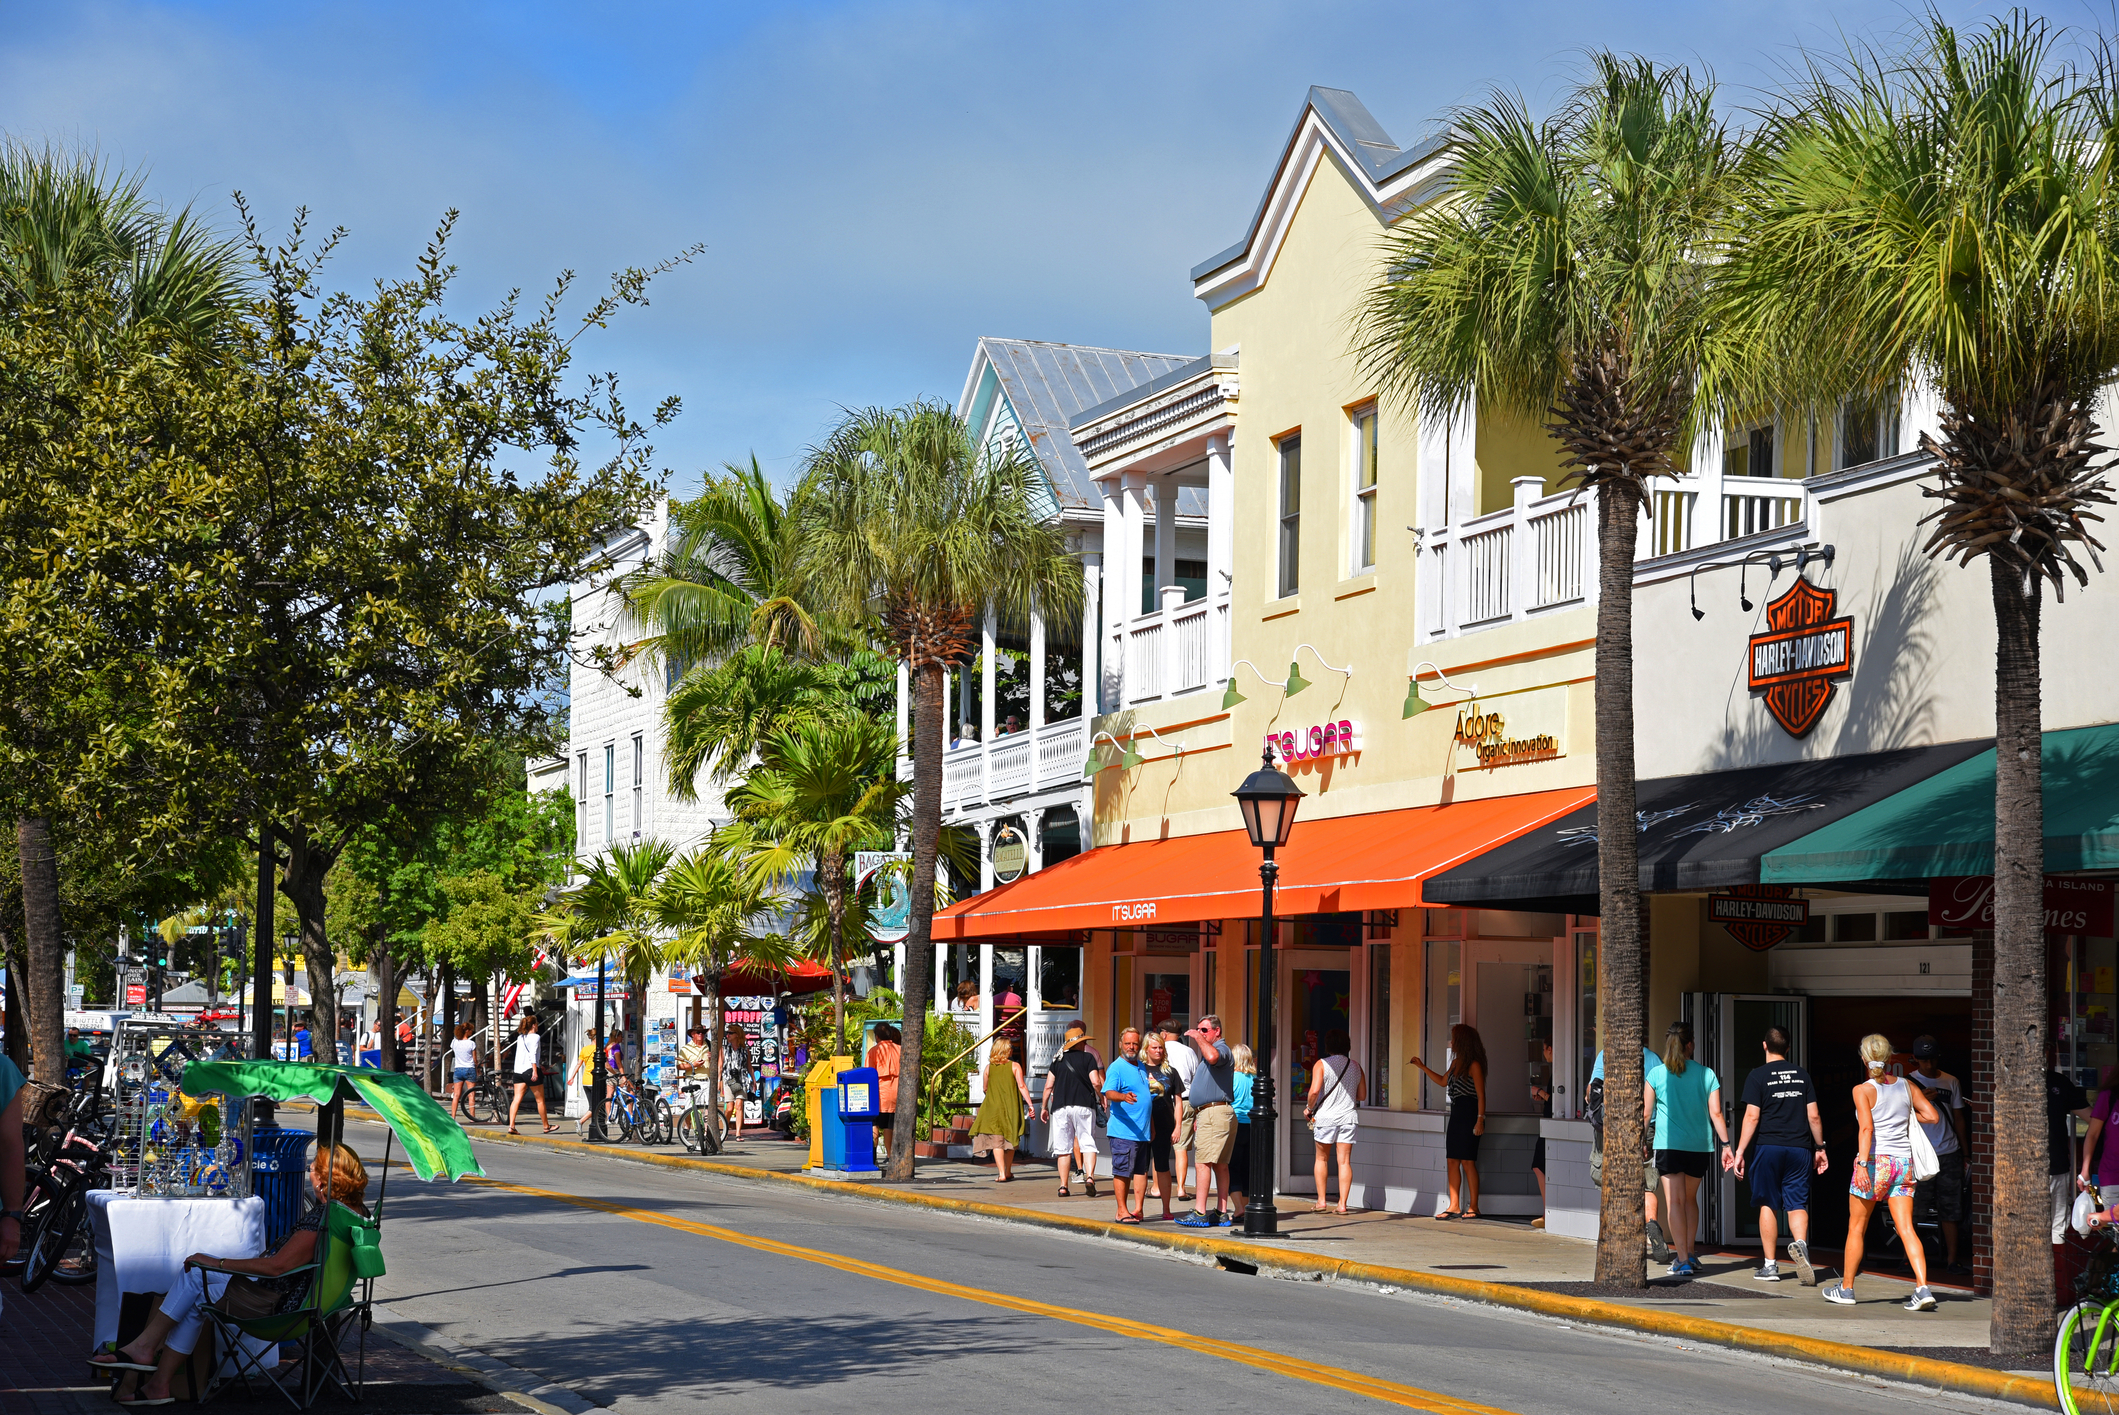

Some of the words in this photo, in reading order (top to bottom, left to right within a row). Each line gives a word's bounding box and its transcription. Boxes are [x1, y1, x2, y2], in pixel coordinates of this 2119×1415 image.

[1776, 590, 1824, 630] MOTOR
[1754, 630, 1846, 677] HARLEY-DAVIDSON
[1774, 679, 1823, 726] CYCLES
[1454, 703, 1502, 740] Adore
[1476, 738, 1507, 762] Organic
[1508, 733, 1555, 755] Innovation
[1737, 884, 1784, 898] MOTOR
[2058, 880, 2105, 891] ISLAND
[1112, 902, 1157, 921] IT'SUGAR
[1715, 899, 1804, 921] HARLEY-DAVIDSON
[1734, 922, 1782, 947] CYCLES
[1919, 962, 1930, 974] 121
